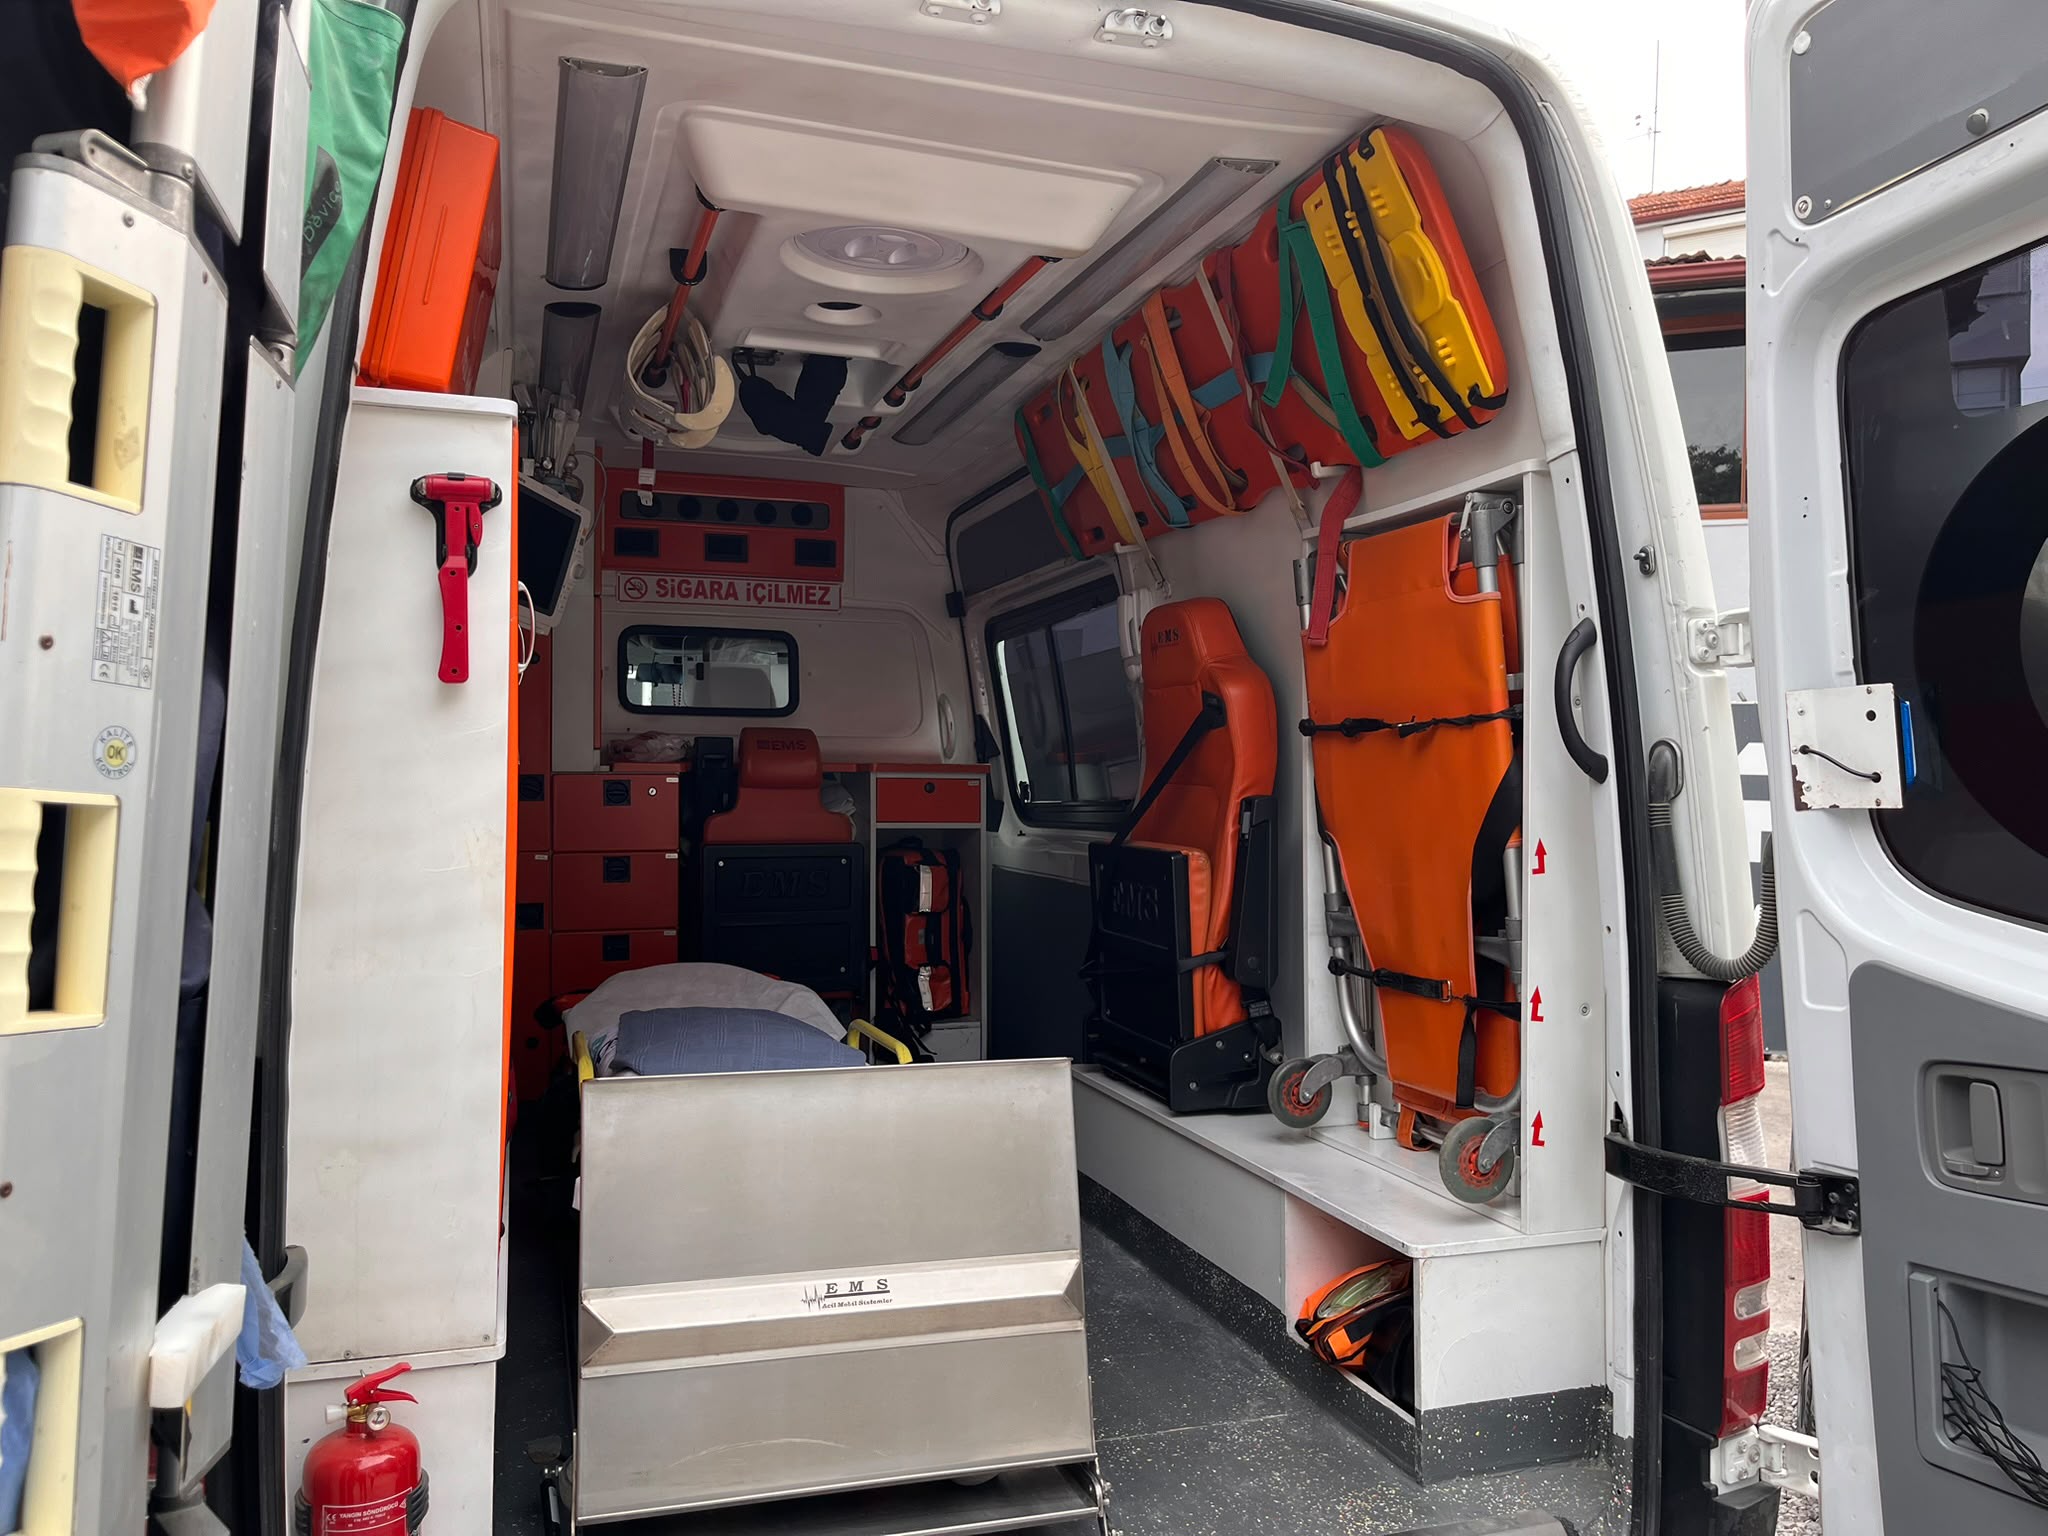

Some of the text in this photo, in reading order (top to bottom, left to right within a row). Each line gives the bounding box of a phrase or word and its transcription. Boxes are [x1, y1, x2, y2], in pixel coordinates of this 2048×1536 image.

[131, 558, 143, 594] EMS
[1157, 627, 1179, 644] EMS
[107, 744, 125, 760] OK
[770, 740, 808, 751] EMS
[96, 757, 134, 777] KONTROL
[742, 871, 831, 897] EMS
